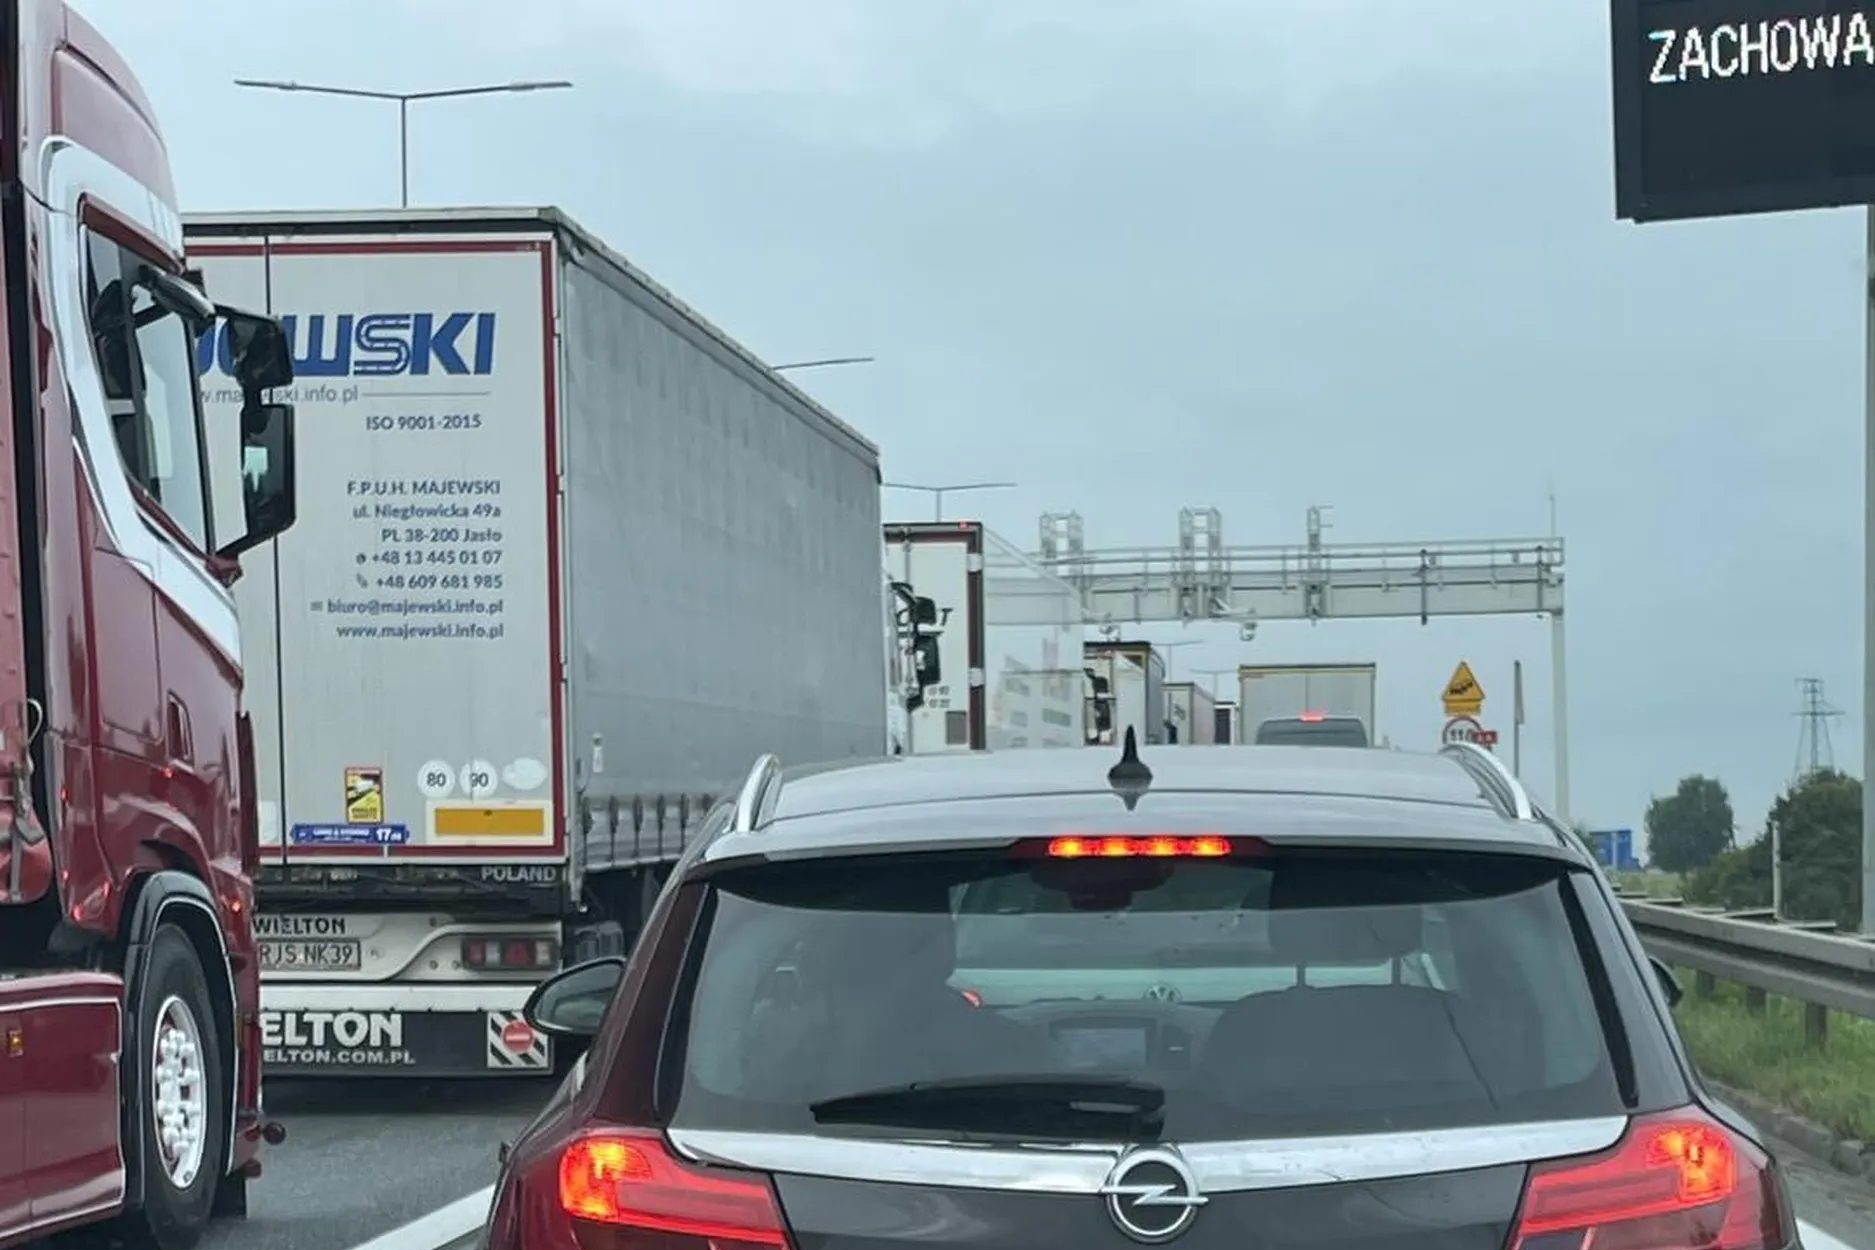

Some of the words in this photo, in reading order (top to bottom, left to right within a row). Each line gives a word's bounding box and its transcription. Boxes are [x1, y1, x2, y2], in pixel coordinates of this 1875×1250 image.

[1648, 12, 1875, 84] ZACHOWA
[366, 416, 394, 431] ISO
[397, 414, 482, 431] 9001-2015
[347, 481, 405, 495] F.P.U.H.
[412, 480, 500, 495] MAJEWSKI
[353, 505, 371, 519] ul.
[472, 504, 501, 518] 49a
[382, 528, 399, 543] PL
[404, 528, 458, 543] 38-200
[372, 551, 400, 565] +48
[404, 550, 423, 565] 13
[426, 550, 456, 565] 445
[459, 550, 478, 565] 01
[482, 550, 502, 565] 07
[376, 575, 405, 589] +48
[408, 575, 437, 589] 609
[441, 575, 469, 589] 681
[474, 574, 503, 589] 985
[328, 598, 503, 616] biuro@majewski.info.pl
[337, 623, 504, 640] www.majewski.info.pl
[426, 772, 447, 788] 80
[469, 772, 489, 788] 90
[481, 865, 557, 882] POLAND
[252, 917, 346, 935] WIELTON
[304, 943, 353, 964] NK39
[259, 1011, 402, 1047] ELTON
[263, 1050, 416, 1064] ELTON.COM.PL
